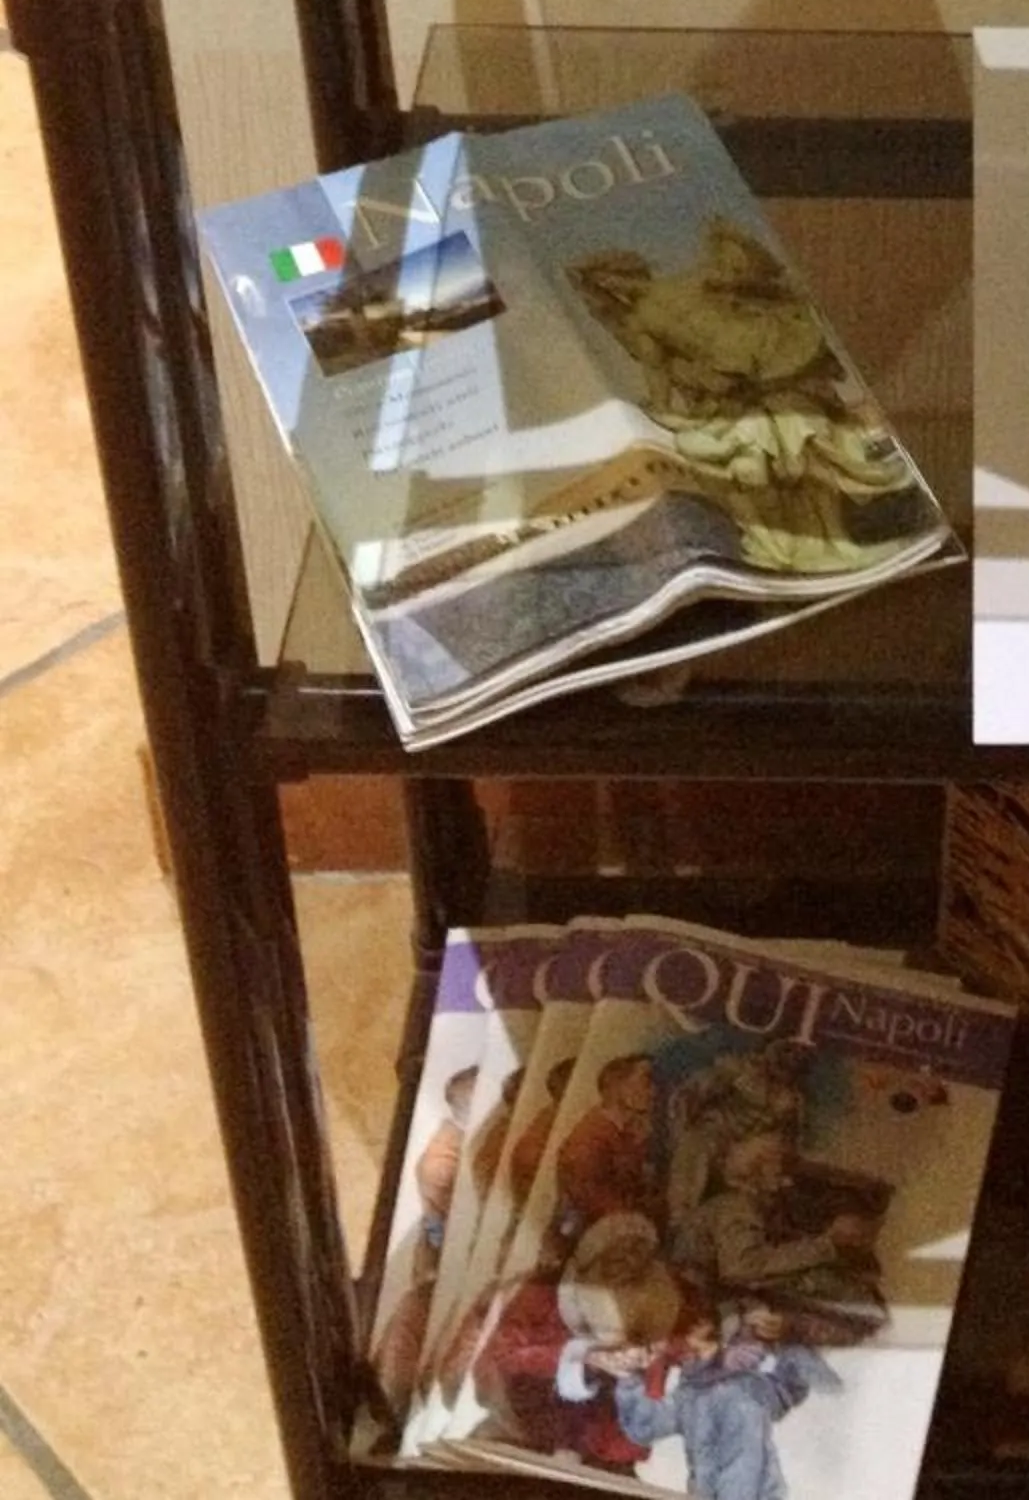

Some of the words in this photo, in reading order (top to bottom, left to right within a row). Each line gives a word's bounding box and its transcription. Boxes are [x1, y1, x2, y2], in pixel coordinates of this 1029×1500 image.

[343, 130, 678, 250] Napoli
[642, 948, 832, 1047] QUI
[833, 996, 970, 1051] Napoli
